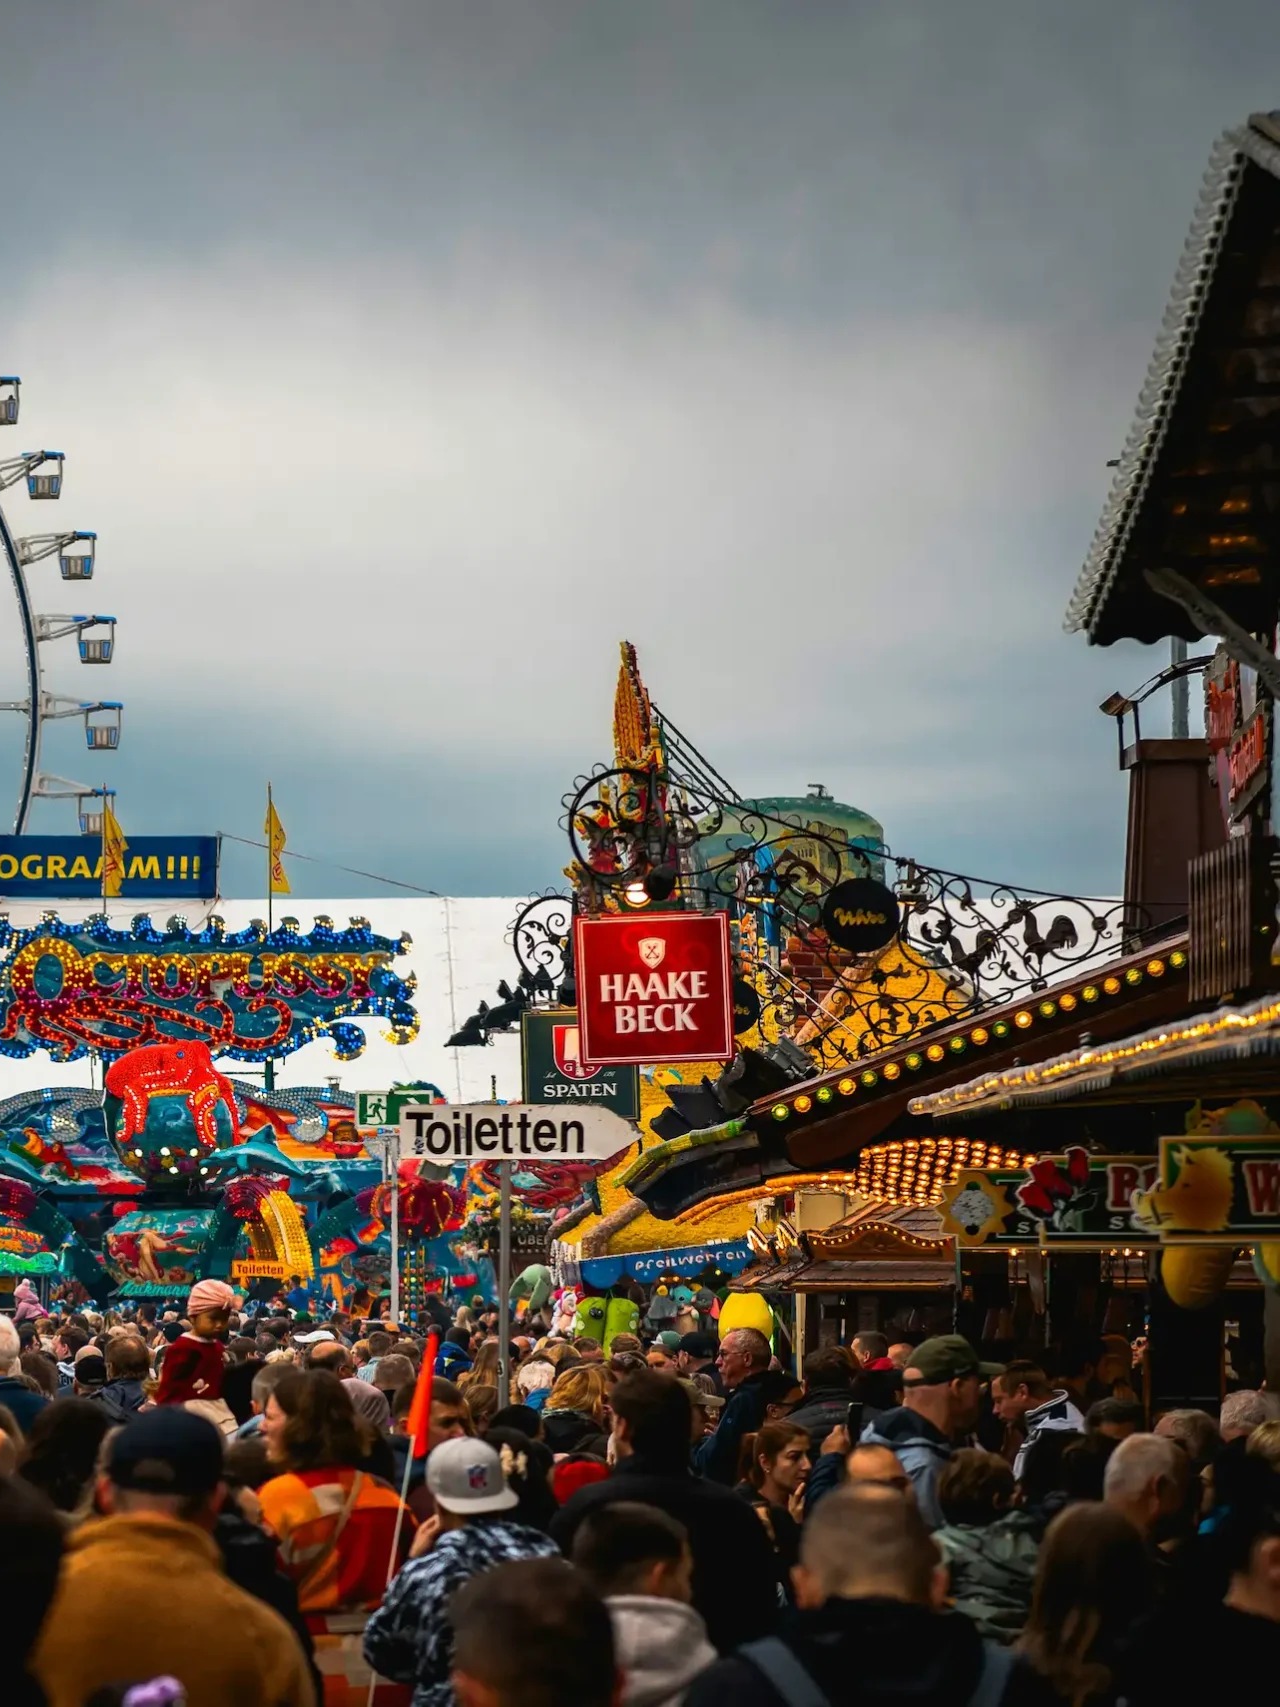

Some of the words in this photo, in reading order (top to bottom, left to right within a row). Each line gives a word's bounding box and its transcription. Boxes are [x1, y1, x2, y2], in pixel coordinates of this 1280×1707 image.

[11, 936, 393, 1003] OCTOPUSSY
[599, 970, 709, 1003] HAAKE
[614, 1002, 699, 1034] BECK
[543, 1083, 618, 1098] SPATEN
[405, 1111, 586, 1156] Toiletten
[236, 1263, 284, 1275] Toiletten
